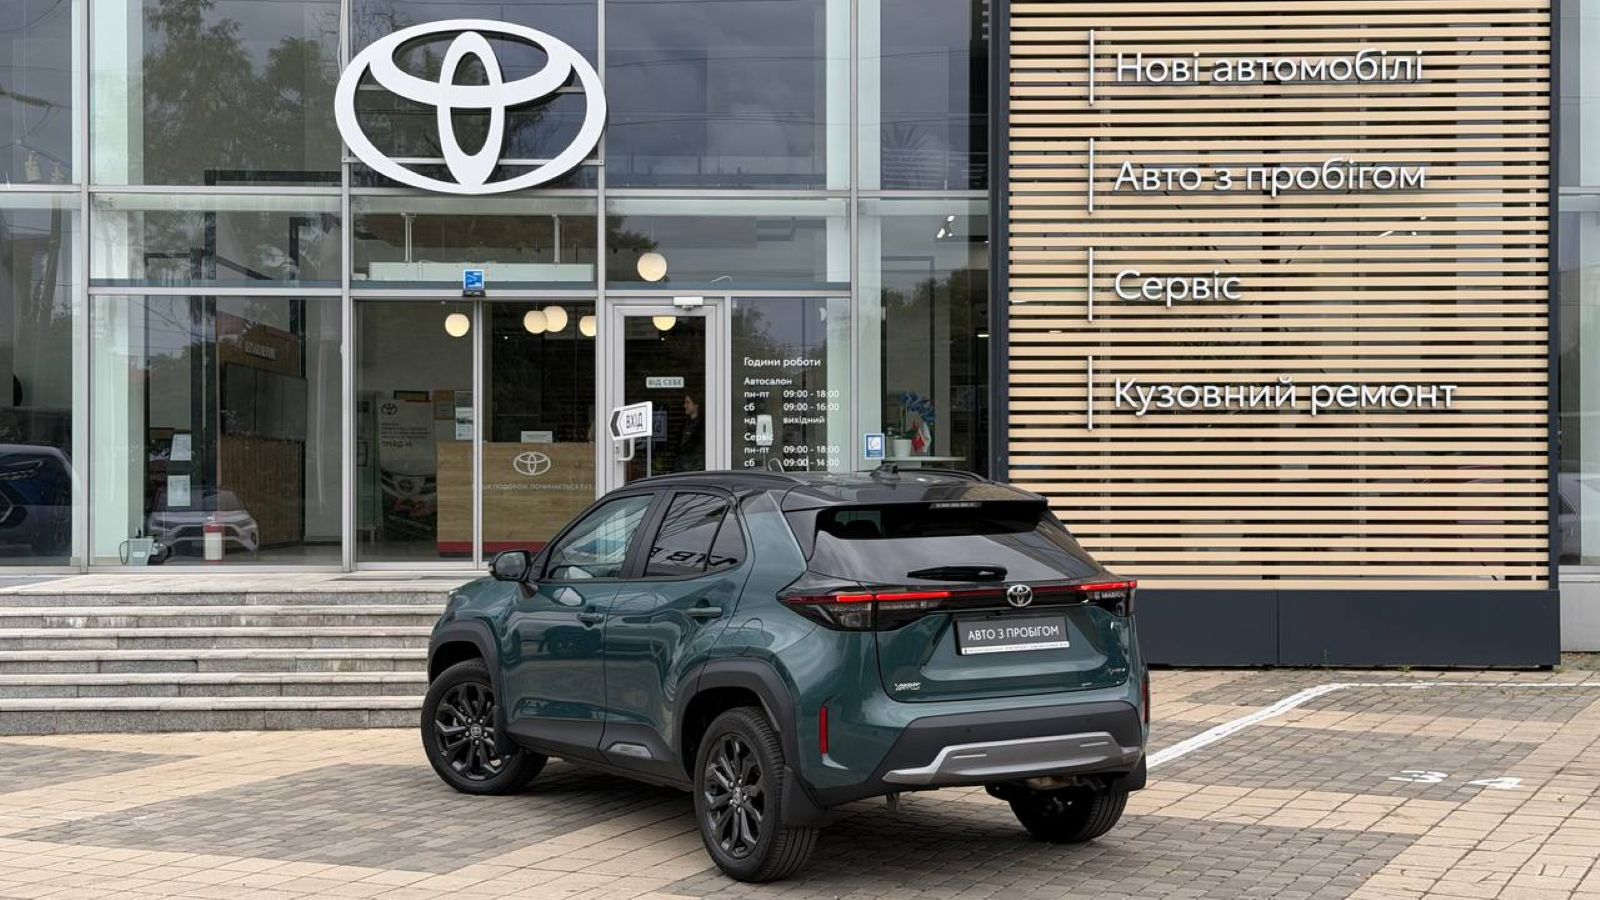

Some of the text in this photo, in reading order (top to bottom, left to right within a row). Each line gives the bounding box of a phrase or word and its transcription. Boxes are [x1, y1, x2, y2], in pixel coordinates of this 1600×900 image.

[1116, 48, 1424, 82] Нові автомобілі
[1114, 157, 1427, 198] Авто з пробігом
[1114, 269, 1242, 308] Сервіс
[744, 357, 821, 368] Години роботи
[744, 377, 792, 386] Автосалон
[783, 390, 808, 398] 09:00
[816, 390, 840, 398] 18:00
[1114, 375, 1458, 417] Кузовний ремонт
[744, 402, 756, 411] сб
[783, 403, 808, 411] 09:00
[816, 403, 840, 411] 16:00
[626, 412, 643, 429] ВХІД
[744, 415, 826, 425] нд вихідний
[744, 432, 774, 441] Сервіс
[744, 458, 756, 467] сб
[783, 459, 808, 467] 09:00
[968, 625, 1060, 641] АВТО З ПРОБІГОМ
